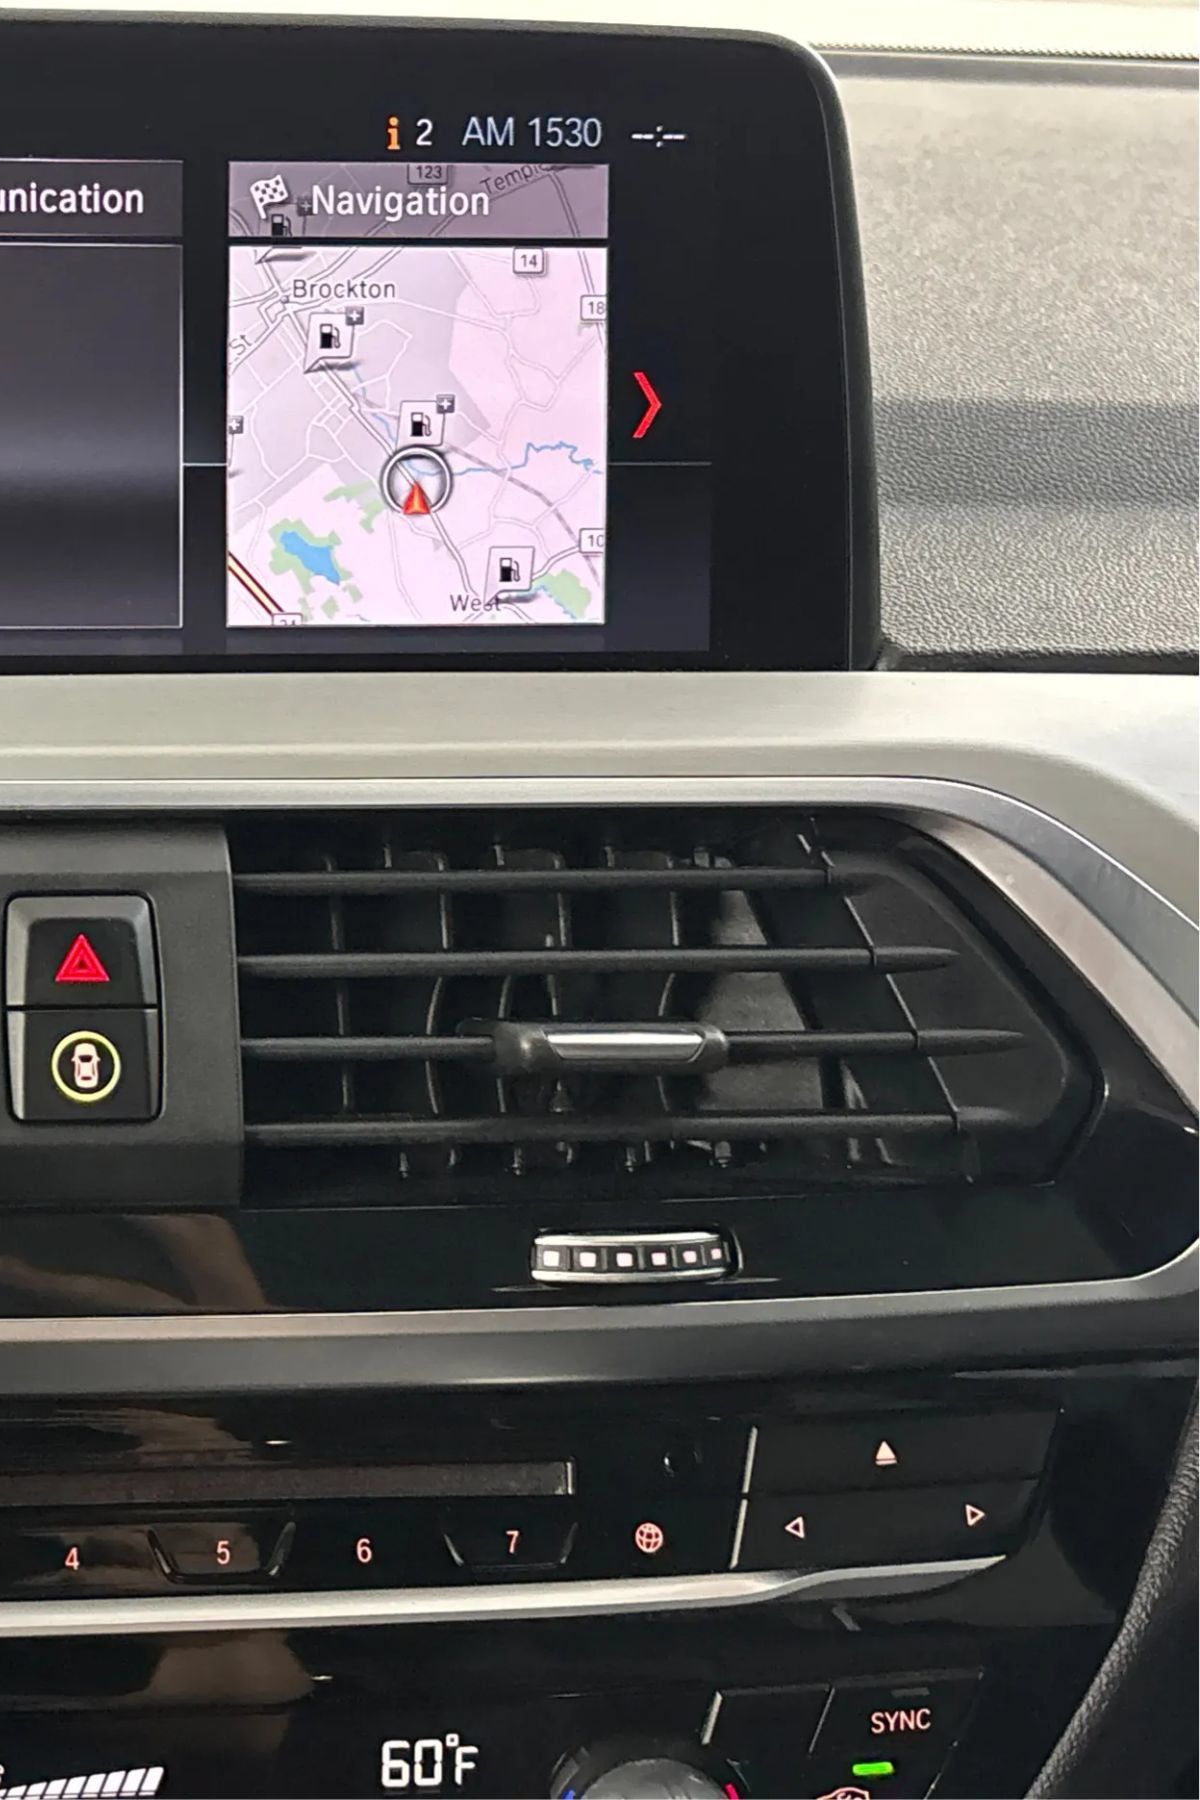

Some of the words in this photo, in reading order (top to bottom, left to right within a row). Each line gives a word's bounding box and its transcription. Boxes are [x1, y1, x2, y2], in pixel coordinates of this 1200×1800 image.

[415, 118, 433, 146] 2
[461, 116, 515, 147] AM
[527, 116, 602, 148] 1530
[415, 164, 443, 181] 123
[311, 183, 491, 222] Navigation
[520, 254, 538, 269] 14
[292, 279, 396, 300] Brockton
[216, 1540, 231, 1566] 5
[355, 1538, 373, 1564] 6
[505, 1530, 521, 1554] 7
[64, 1546, 81, 1571] 4
[870, 1707, 932, 1735] SYNC
[381, 1732, 480, 1788] 60°F
